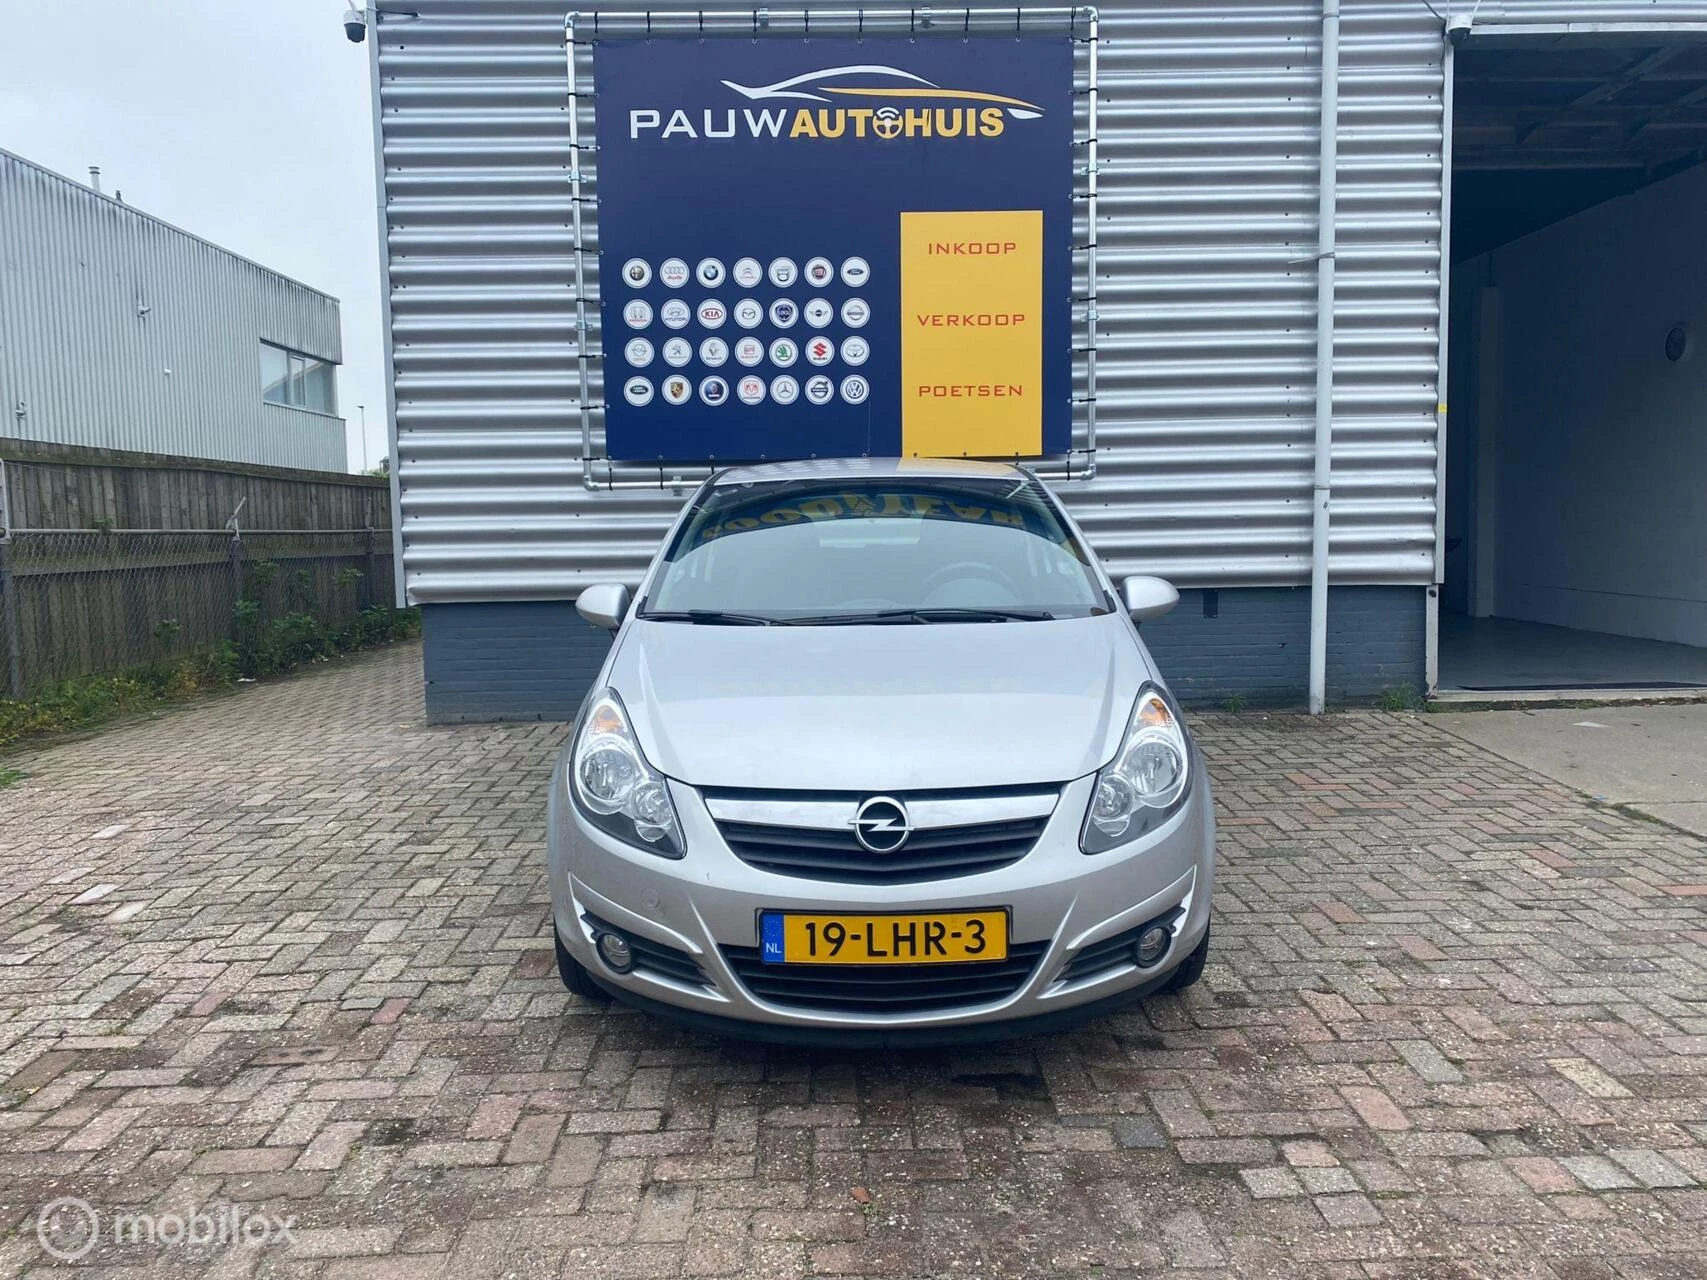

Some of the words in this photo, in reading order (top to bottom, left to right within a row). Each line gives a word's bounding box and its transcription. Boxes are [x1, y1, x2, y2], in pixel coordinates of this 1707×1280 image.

[928, 242, 1017, 255] INKOOP
[704, 310, 720, 318] KIA
[917, 314, 1026, 327] VERKOOP
[919, 385, 1023, 398] POETSEN
[805, 919, 987, 957] 19-LHR-3
[766, 943, 782, 955] NL
